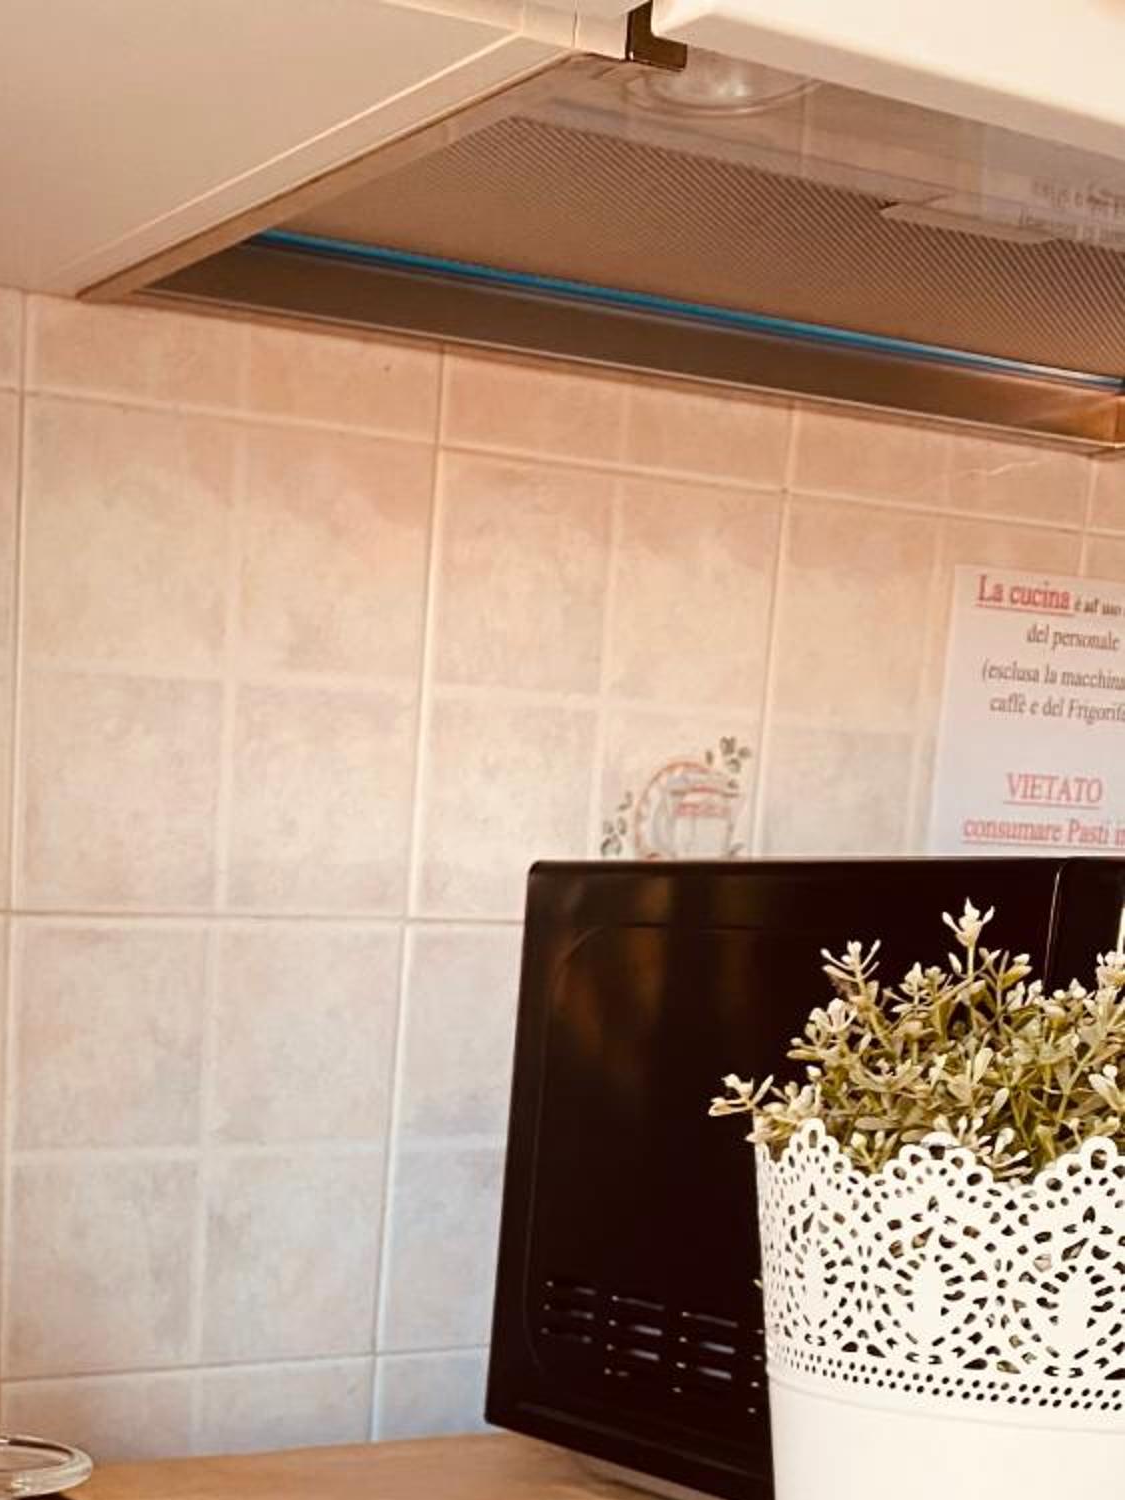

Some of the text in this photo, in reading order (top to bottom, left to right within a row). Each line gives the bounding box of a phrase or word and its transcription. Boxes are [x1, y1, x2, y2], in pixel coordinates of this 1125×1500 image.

[977, 574, 1004, 603] La
[1009, 580, 1071, 610] cucina
[1026, 623, 1121, 651] del personale
[982, 658, 1040, 684] (esclusa
[1044, 663, 1058, 684] la
[989, 692, 1026, 714] caffè
[1029, 701, 1040, 715] e
[1042, 697, 1065, 718] del
[1006, 772, 1103, 803] VIETATO
[963, 819, 1063, 842] consumare
[1068, 818, 1110, 845] Pasti
